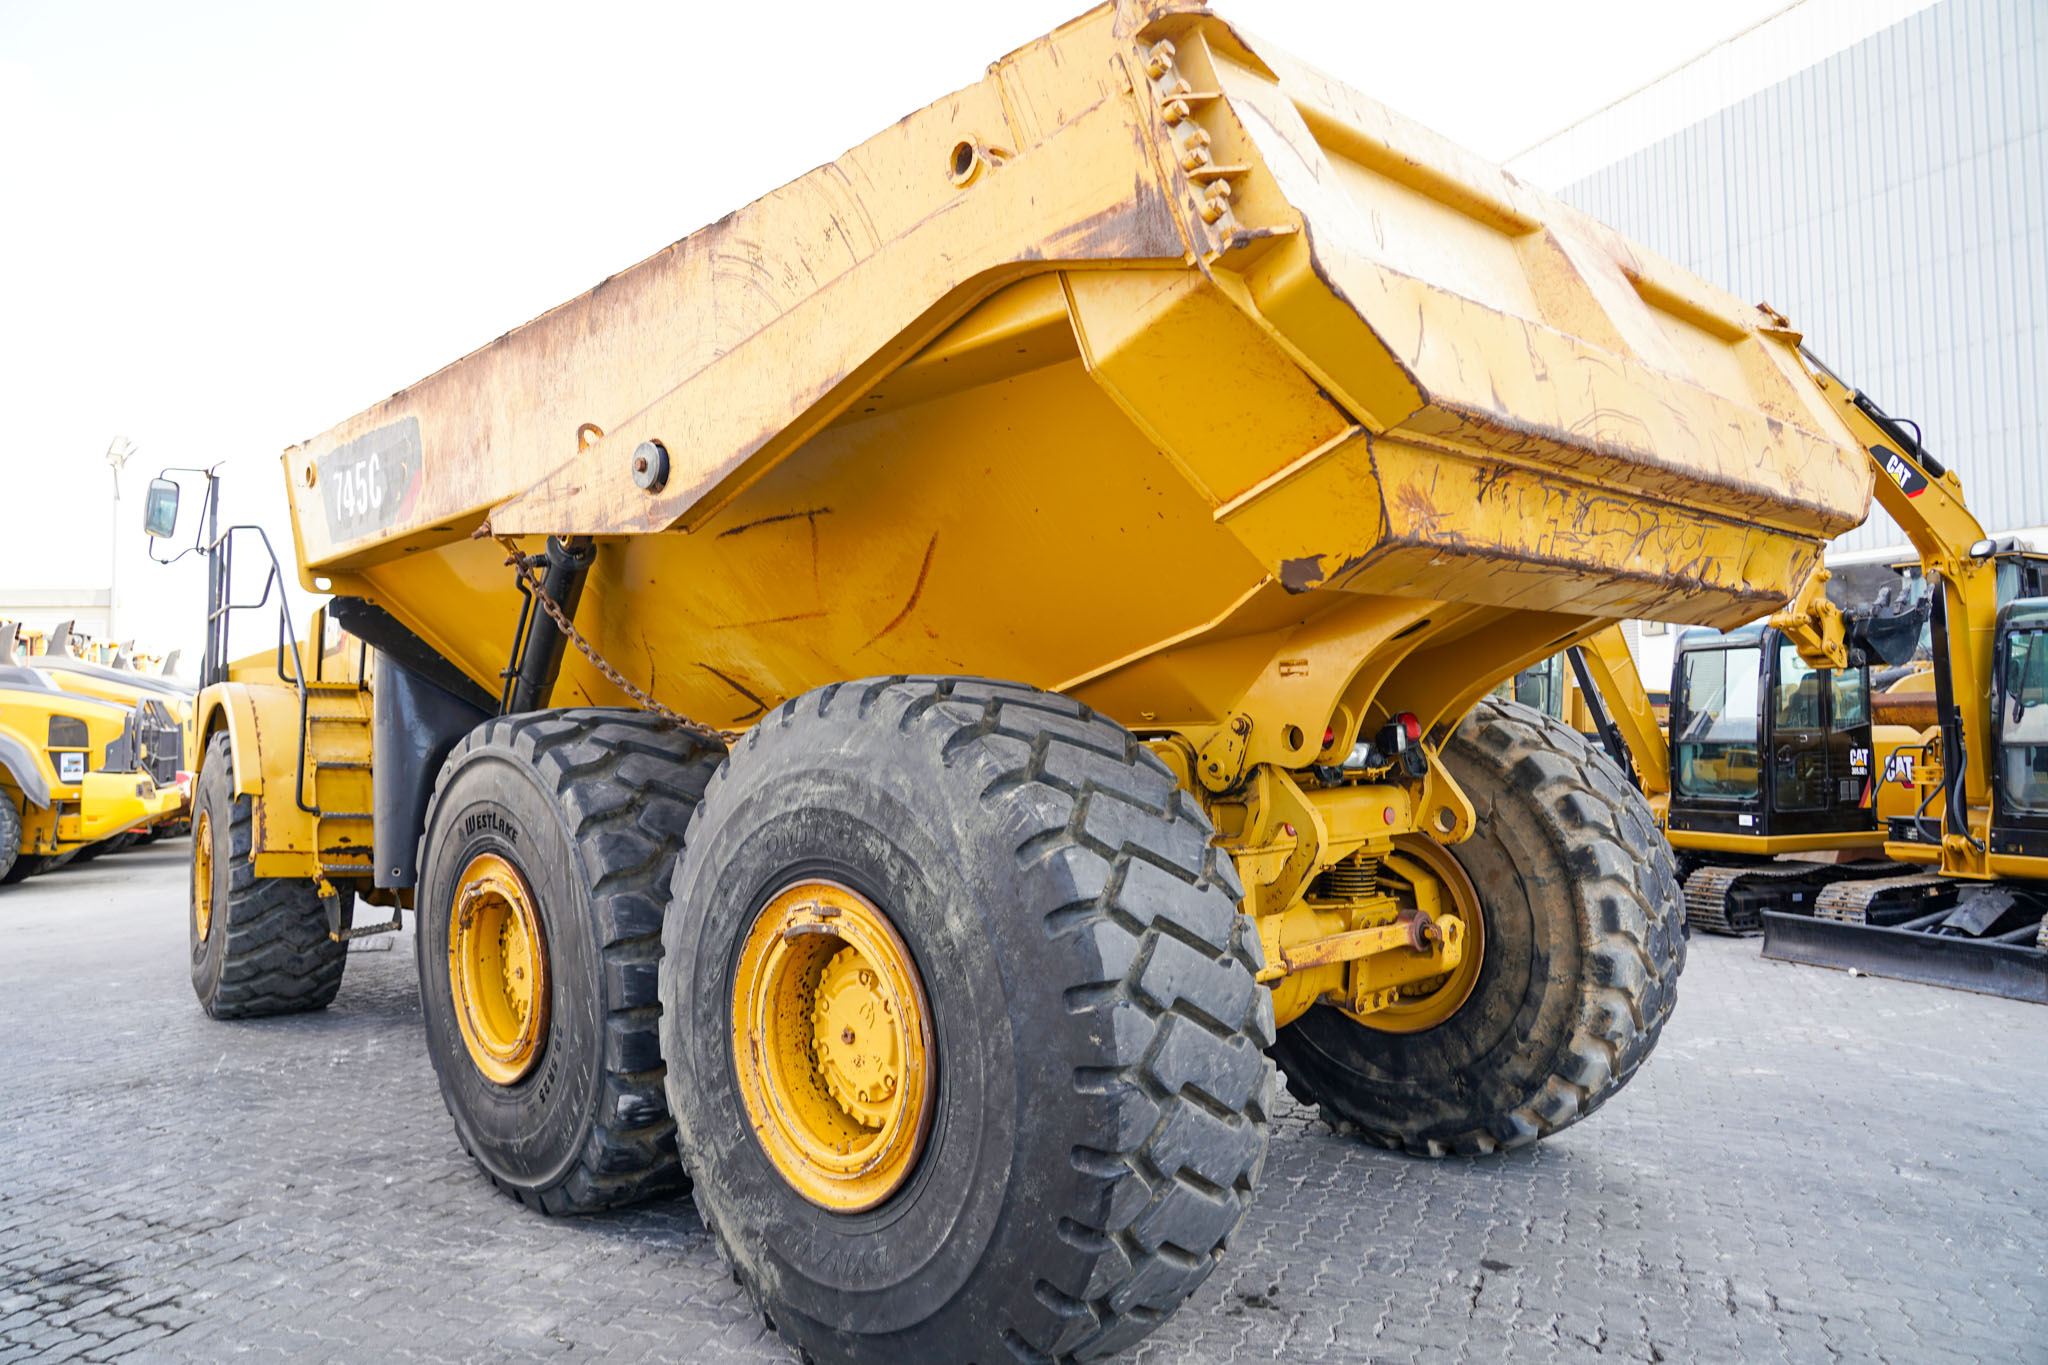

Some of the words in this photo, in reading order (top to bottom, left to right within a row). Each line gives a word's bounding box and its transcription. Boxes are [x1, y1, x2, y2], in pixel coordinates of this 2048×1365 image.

[333, 452, 382, 521] 745C
[1886, 454, 1912, 489] CAT
[1850, 748, 1869, 767] CAT
[1885, 755, 1914, 783] CAT
[465, 812, 519, 845] WESTLAKE
[539, 1023, 563, 1105] 29.5R25
